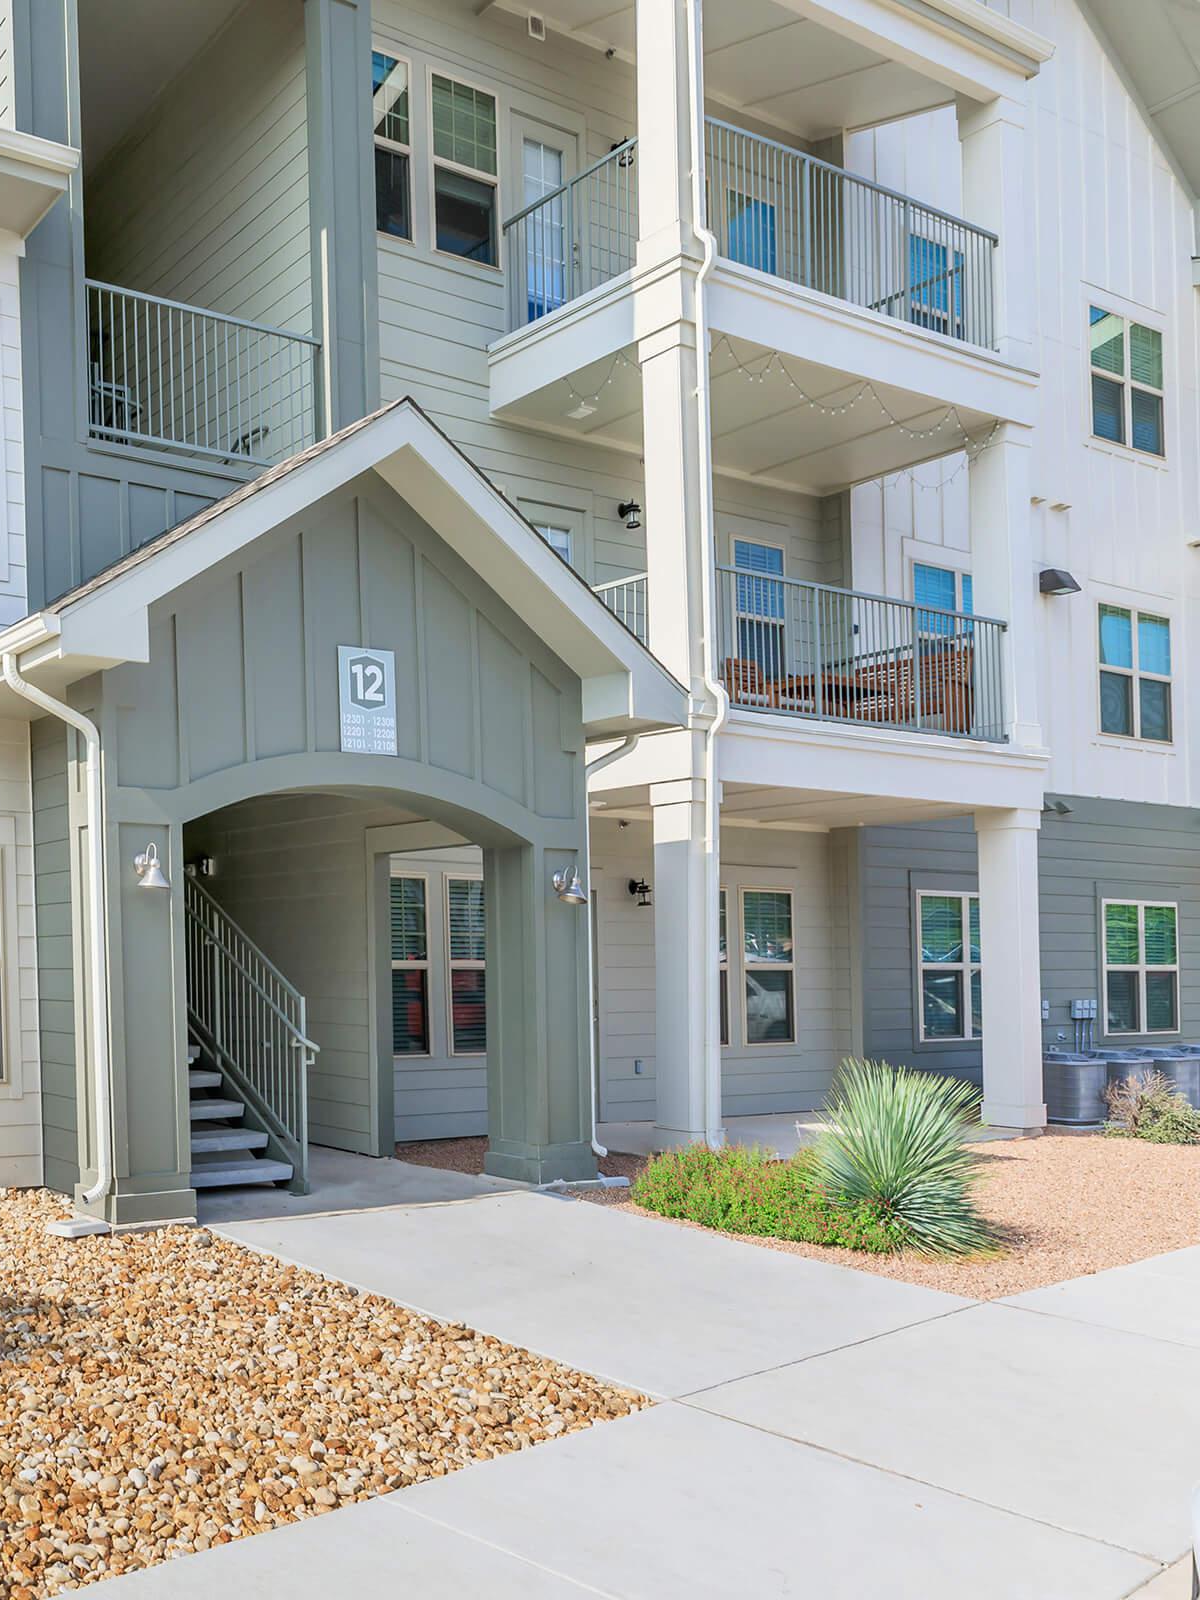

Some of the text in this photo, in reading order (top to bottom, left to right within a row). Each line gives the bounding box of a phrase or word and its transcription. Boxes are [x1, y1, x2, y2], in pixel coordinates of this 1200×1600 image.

[351, 663, 384, 702] 12
[343, 713, 365, 725] 12301
[343, 726, 365, 737] 12201
[343, 737, 366, 749] 12101
